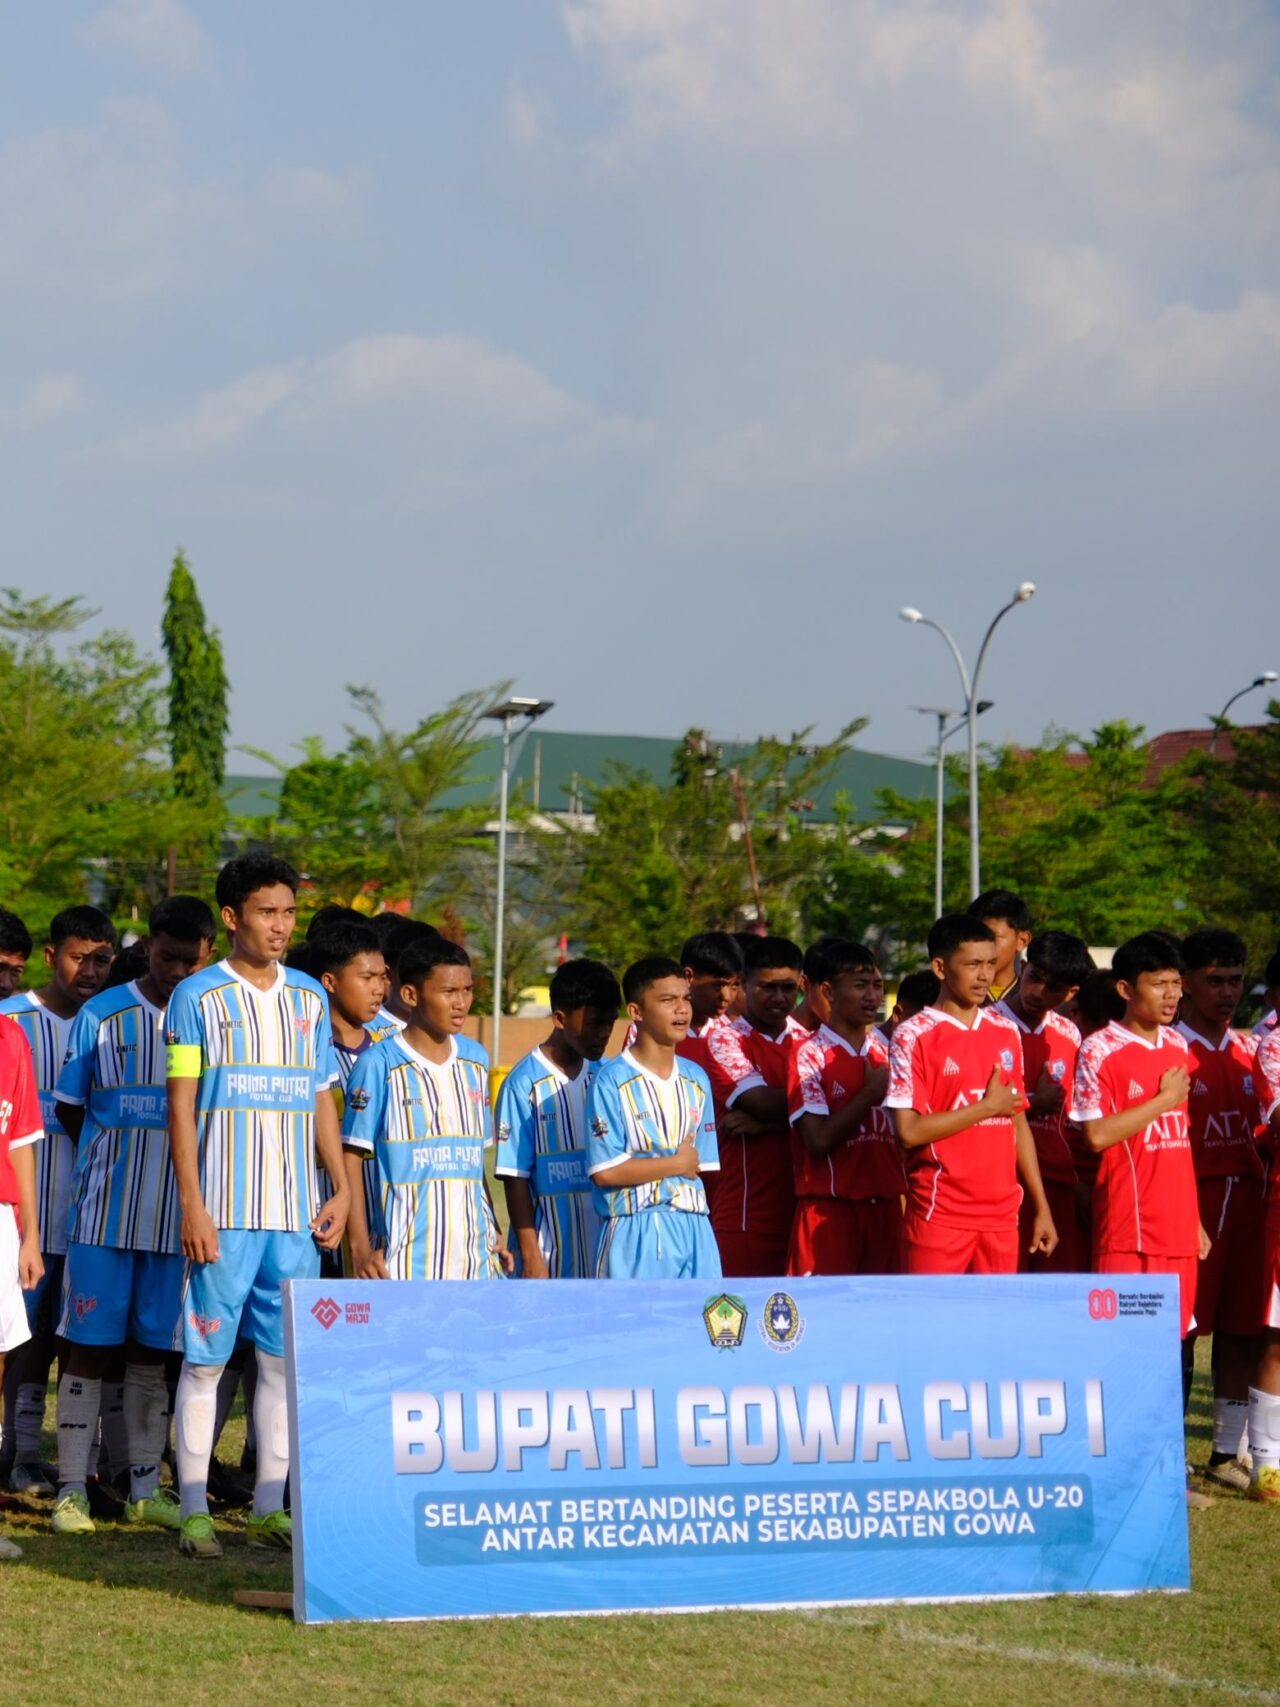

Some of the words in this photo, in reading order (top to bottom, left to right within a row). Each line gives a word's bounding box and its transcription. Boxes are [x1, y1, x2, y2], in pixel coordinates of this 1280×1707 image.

[227, 1073, 268, 1098] PRIMA
[272, 1076, 309, 1101] PUTRA
[952, 1089, 986, 1111] AT
[120, 1094, 157, 1118] PRIMA
[345, 1303, 371, 1313] GOWA
[1088, 1288, 1117, 1320] 80
[345, 1313, 370, 1324] MAJU
[392, 1387, 658, 1475] BUPATI
[677, 1382, 911, 1466] GOWA
[923, 1379, 1068, 1461] CUP
[1085, 1379, 1107, 1458] I
[424, 1500, 552, 1528] SELAMAT
[560, 1495, 736, 1523] BERTANDING
[745, 1490, 860, 1517] PESERTA
[867, 1486, 1020, 1514] SEPAKBOLA
[1028, 1485, 1083, 1509] U-20
[482, 1526, 575, 1552] ANTAR
[583, 1521, 750, 1548] KECAMATAN
[758, 1513, 946, 1542] SEKABUPATEN
[954, 1511, 1035, 1536] GOWA
